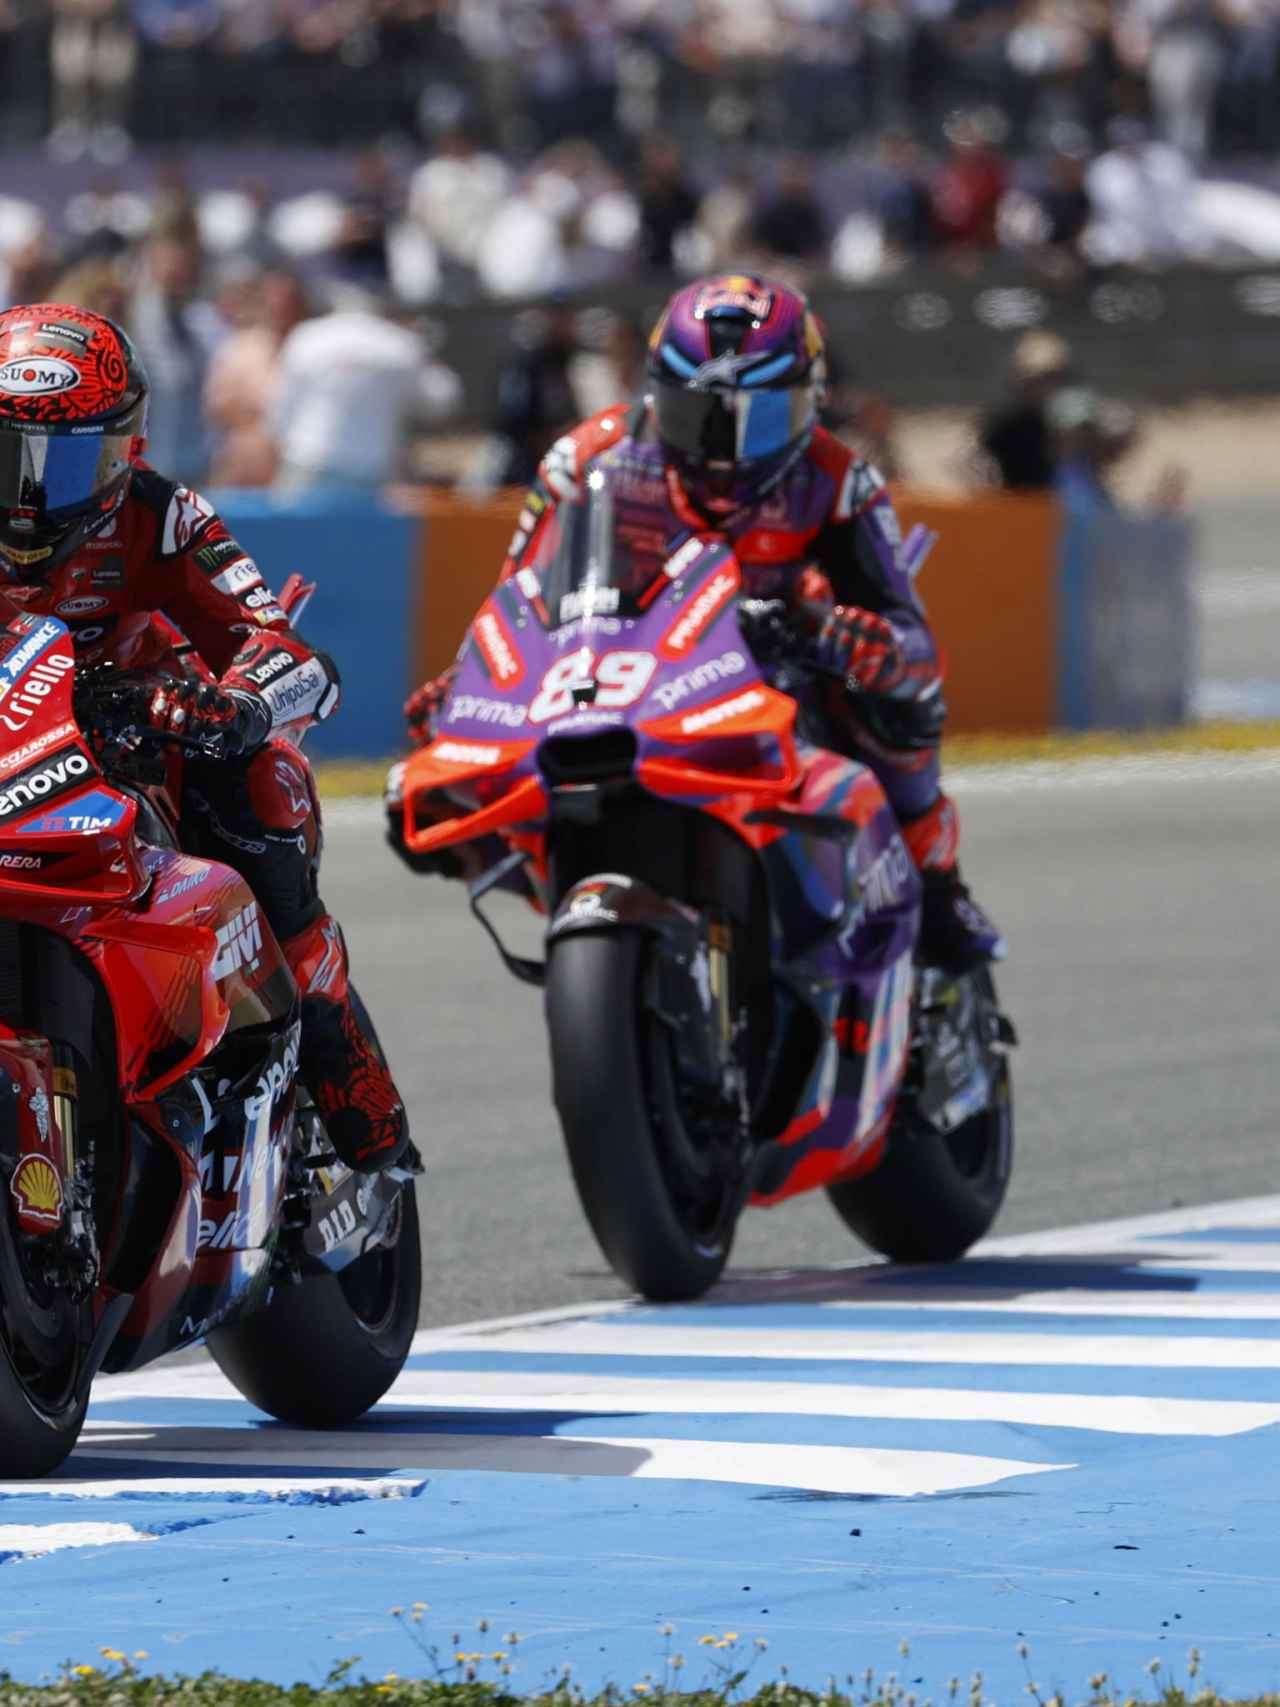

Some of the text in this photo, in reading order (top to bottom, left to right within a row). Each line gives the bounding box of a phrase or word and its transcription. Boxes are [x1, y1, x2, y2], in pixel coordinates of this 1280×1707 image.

[41, 322, 85, 342] Lenovo
[0, 366, 70, 387] SUOMY
[245, 651, 294, 684] Lenovo
[654, 651, 747, 710] prima
[9, 652, 75, 717] riello
[528, 648, 658, 725] 89
[447, 695, 528, 728] prima
[68, 815, 112, 830] TIM
